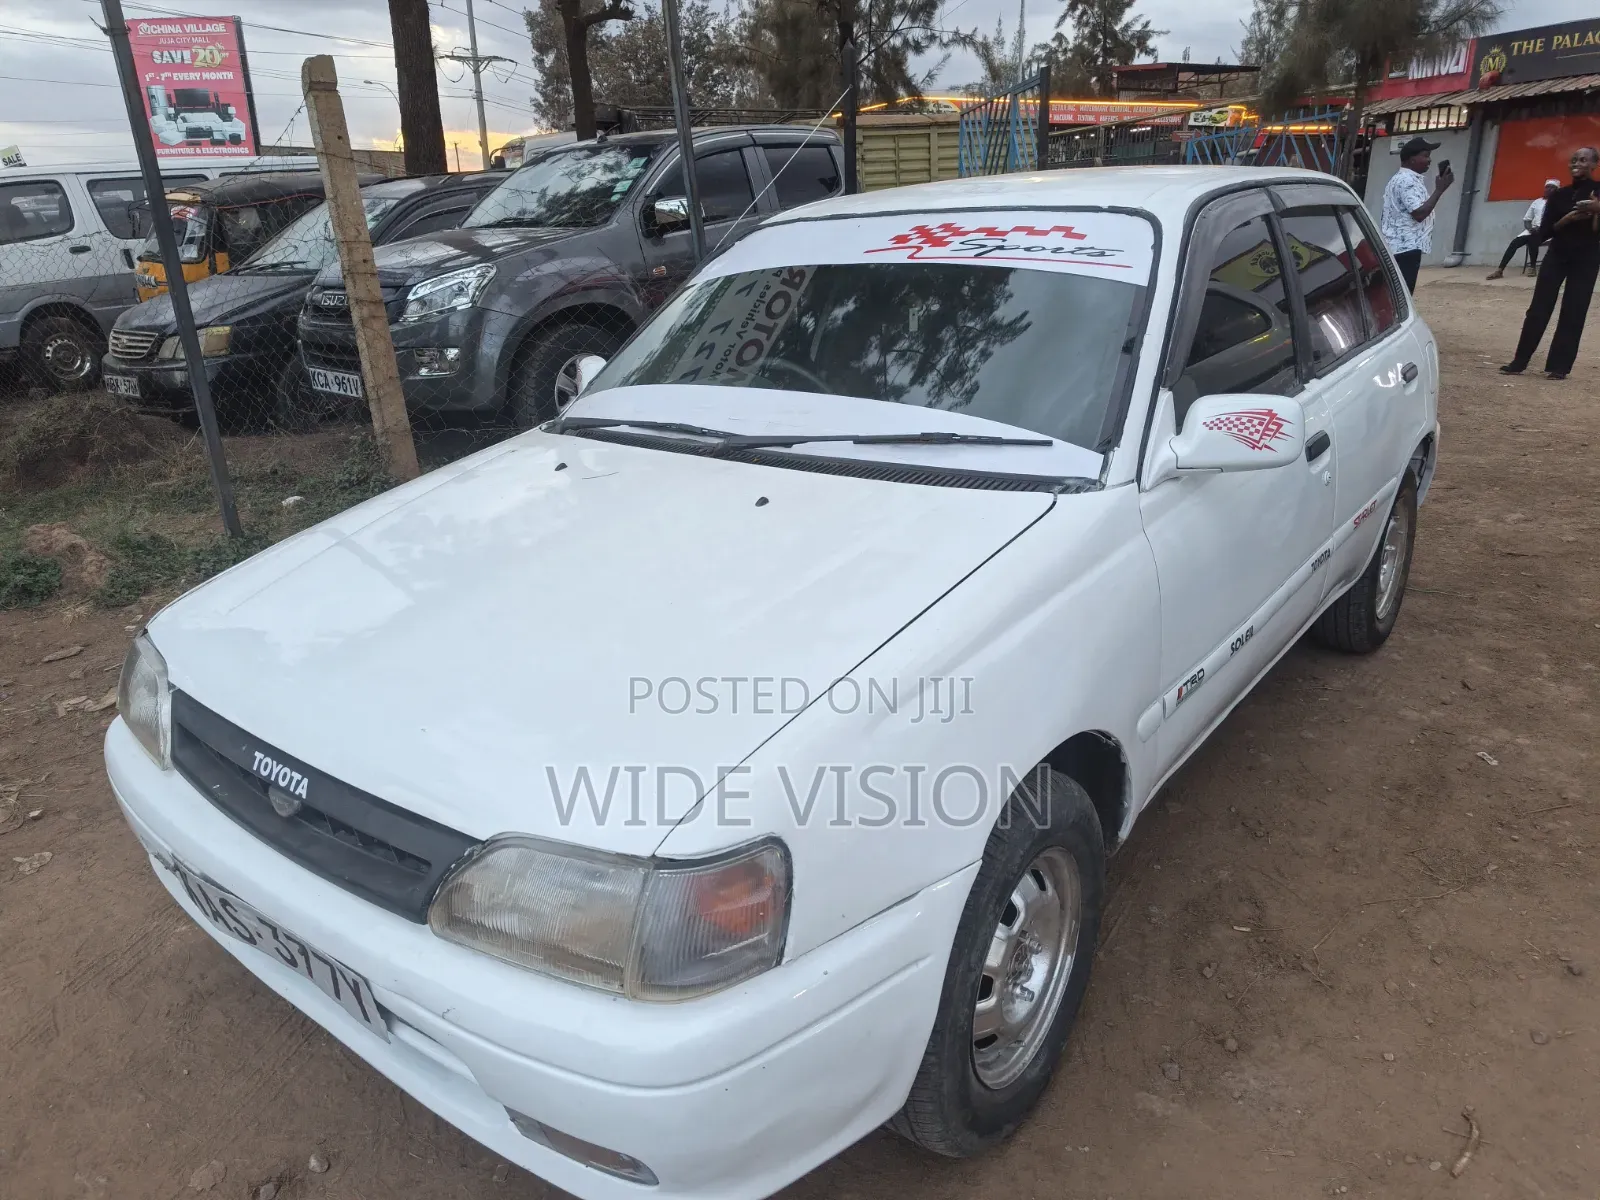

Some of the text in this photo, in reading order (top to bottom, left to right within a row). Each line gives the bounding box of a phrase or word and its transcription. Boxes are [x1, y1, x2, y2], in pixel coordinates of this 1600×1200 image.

[151, 23, 227, 34] CHINA VILLAGE
[1511, 38, 1545, 56] THE
[152, 50, 192, 64] SAVE
[173, 72, 200, 80] EVERY
[202, 71, 234, 80] MONTH
[2, 153, 22, 166] SALE
[950, 238, 1124, 257] Sports
[1311, 548, 1330, 573] TOYOTA
[253, 750, 309, 799] TOYOTA
